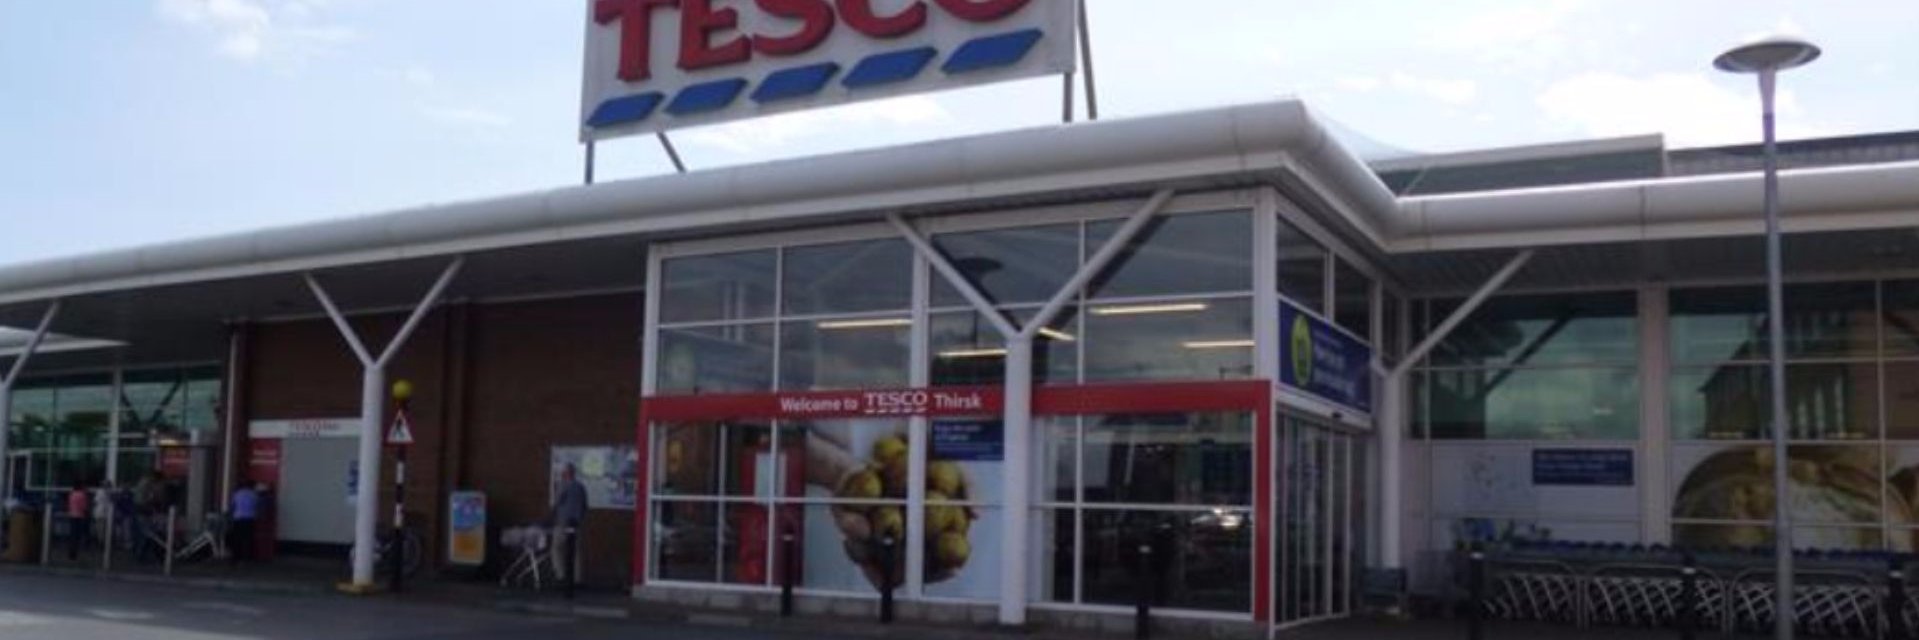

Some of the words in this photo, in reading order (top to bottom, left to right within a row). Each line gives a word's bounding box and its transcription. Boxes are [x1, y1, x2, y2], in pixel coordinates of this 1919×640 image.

[593, 0, 1031, 81] TES
[781, 397, 840, 411] Welcome
[844, 397, 858, 410] to
[866, 391, 927, 410] TESCO
[935, 391, 981, 408] Thirsk
